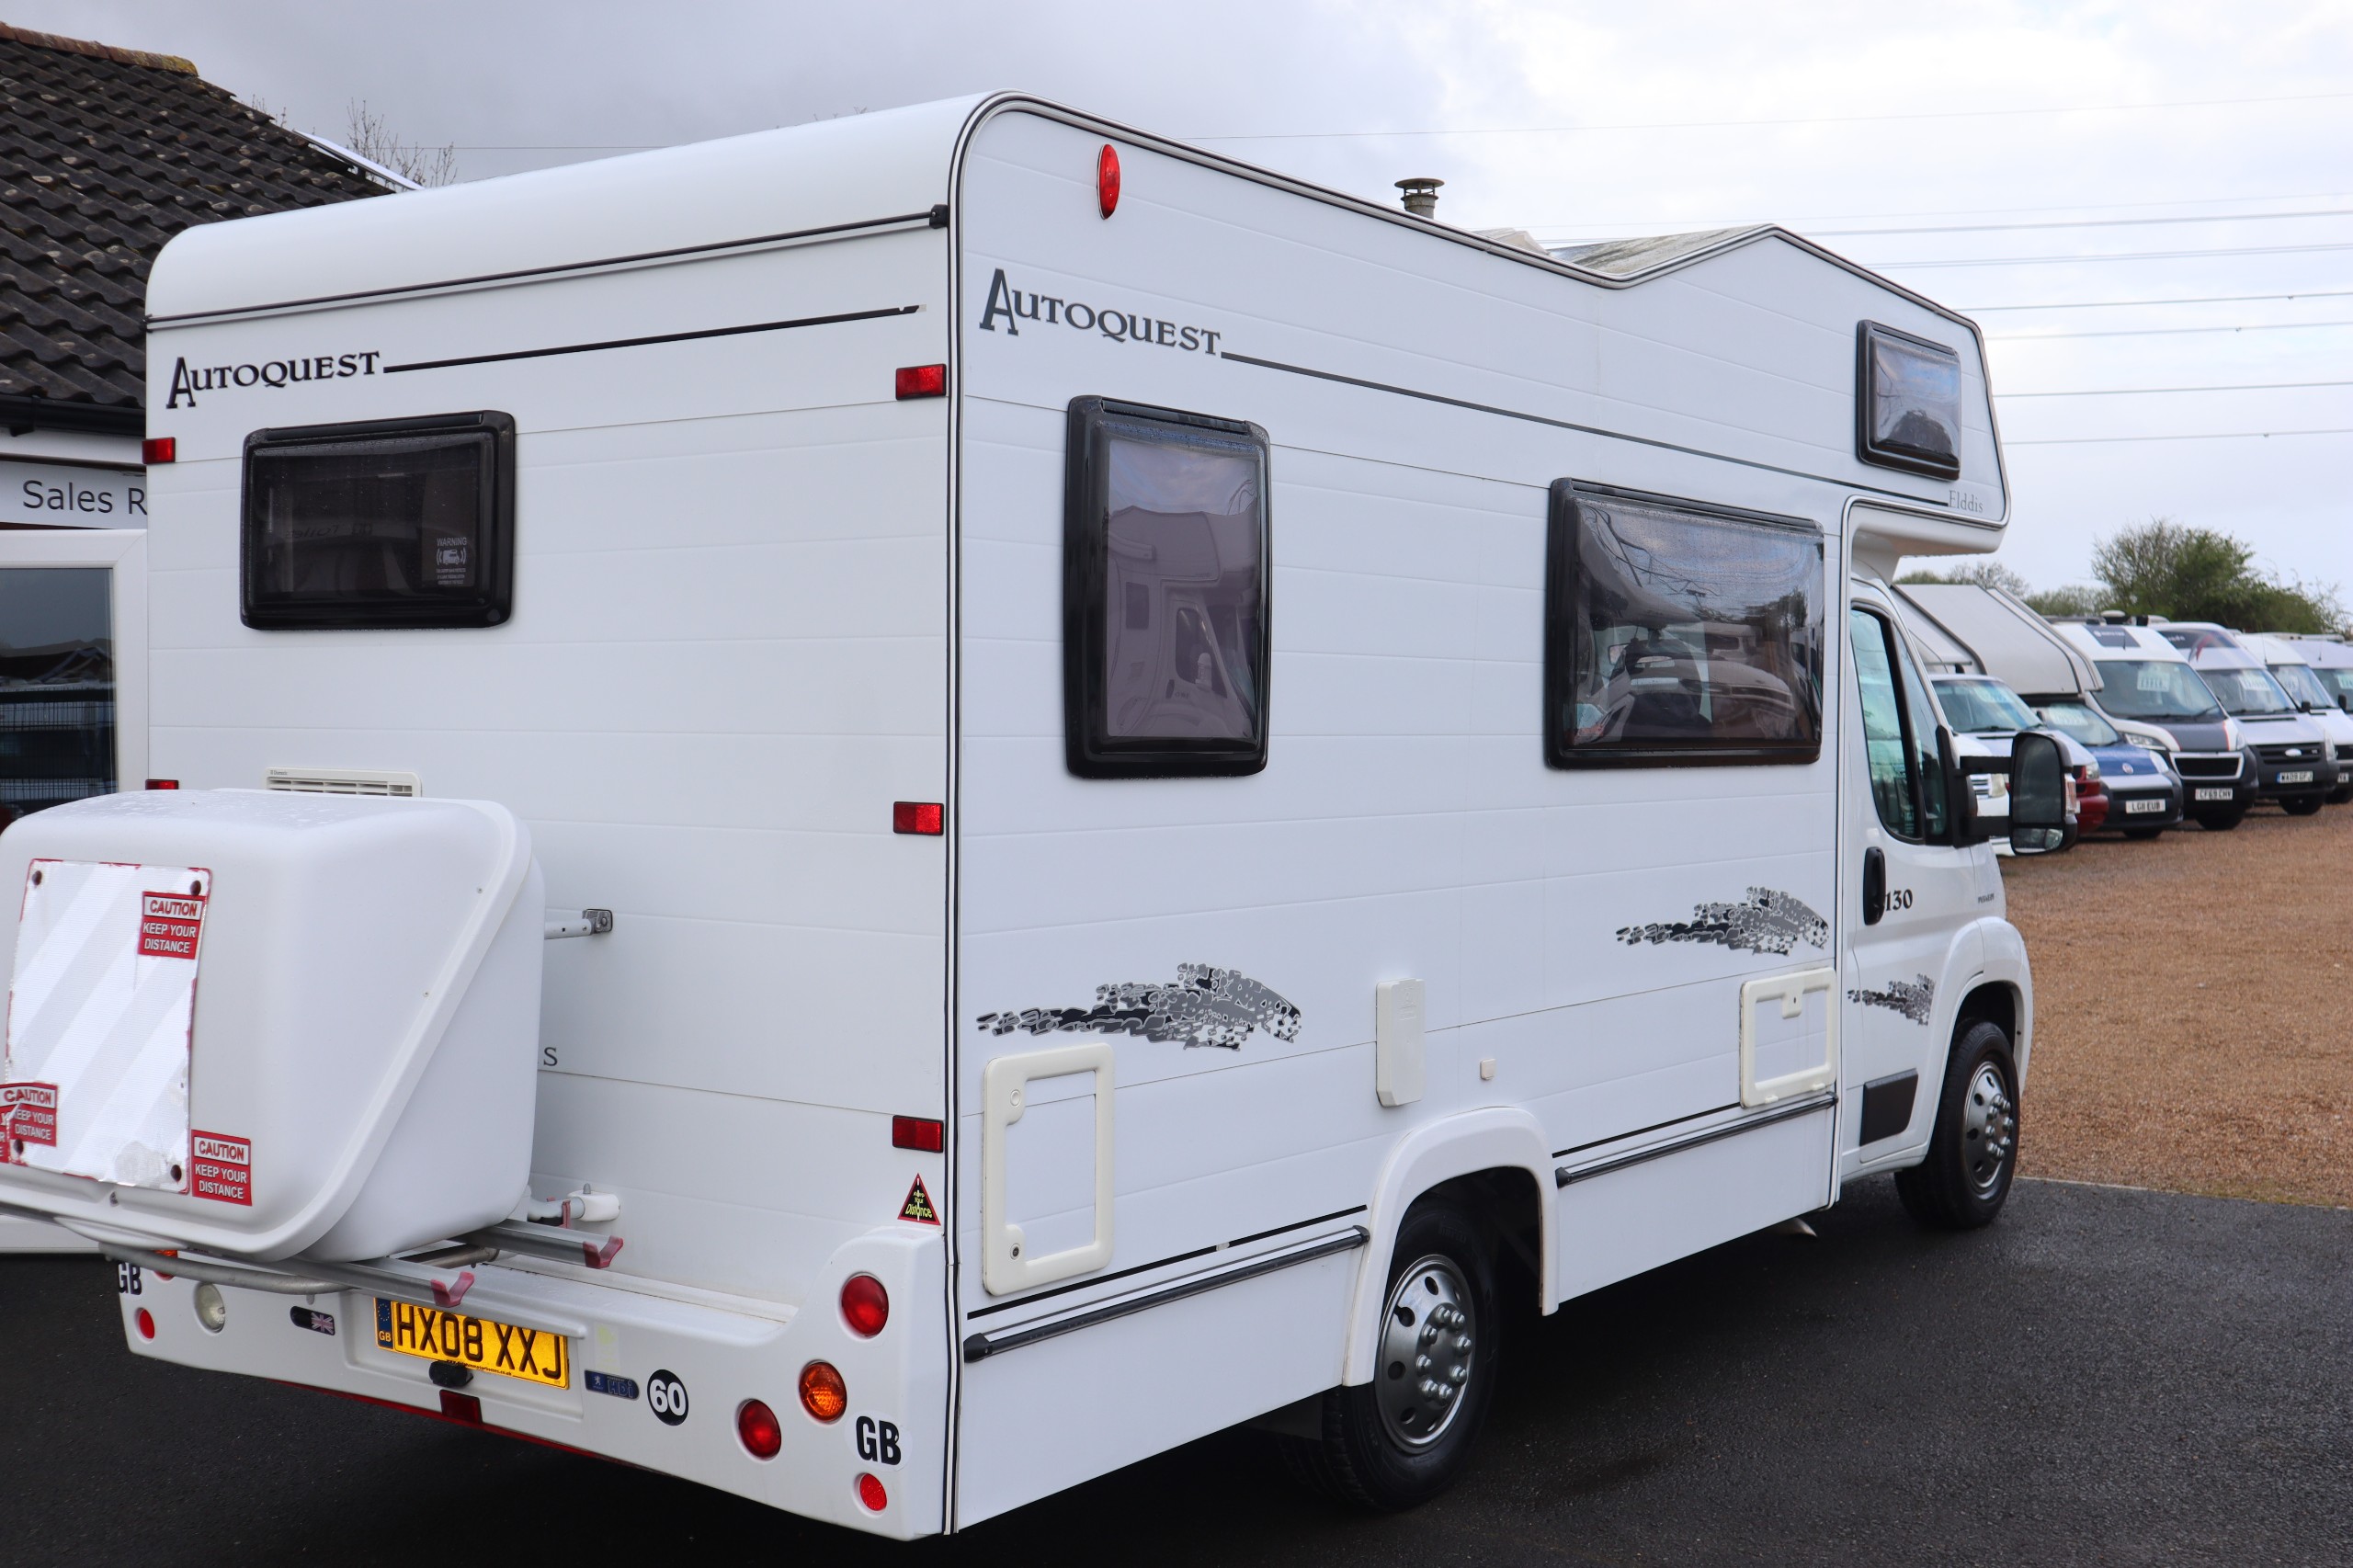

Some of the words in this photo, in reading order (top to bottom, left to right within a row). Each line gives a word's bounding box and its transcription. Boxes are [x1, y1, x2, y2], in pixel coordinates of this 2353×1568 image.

[979, 267, 1221, 356] AUTOQUEST
[166, 351, 380, 409] AUTOQUEST
[23, 480, 113, 514] Sales
[1949, 489, 1984, 514] Elddis
[437, 537, 467, 547] WARNING
[150, 900, 198, 916] CAUTION
[1885, 889, 1914, 912] 130
[142, 922, 168, 935] KEEP
[170, 925, 197, 938] YOUR
[144, 937, 190, 954] DISTANCE
[4, 1089, 51, 1105] CAUTION
[32, 1111, 54, 1126] YOUR
[15, 1123, 51, 1141] DISTANCE
[199, 1140, 244, 1162] CAUTION
[195, 1164, 220, 1178] KEEP
[221, 1167, 247, 1184] YOUR
[199, 1180, 244, 1199] DISTANCE
[905, 1204, 933, 1219] Distance
[119, 1261, 142, 1295] GB
[379, 1330, 392, 1343] GB
[396, 1302, 483, 1363] HX08
[493, 1322, 562, 1381] XXJ
[650, 1379, 687, 1416] 60
[856, 1415, 902, 1466] GB
